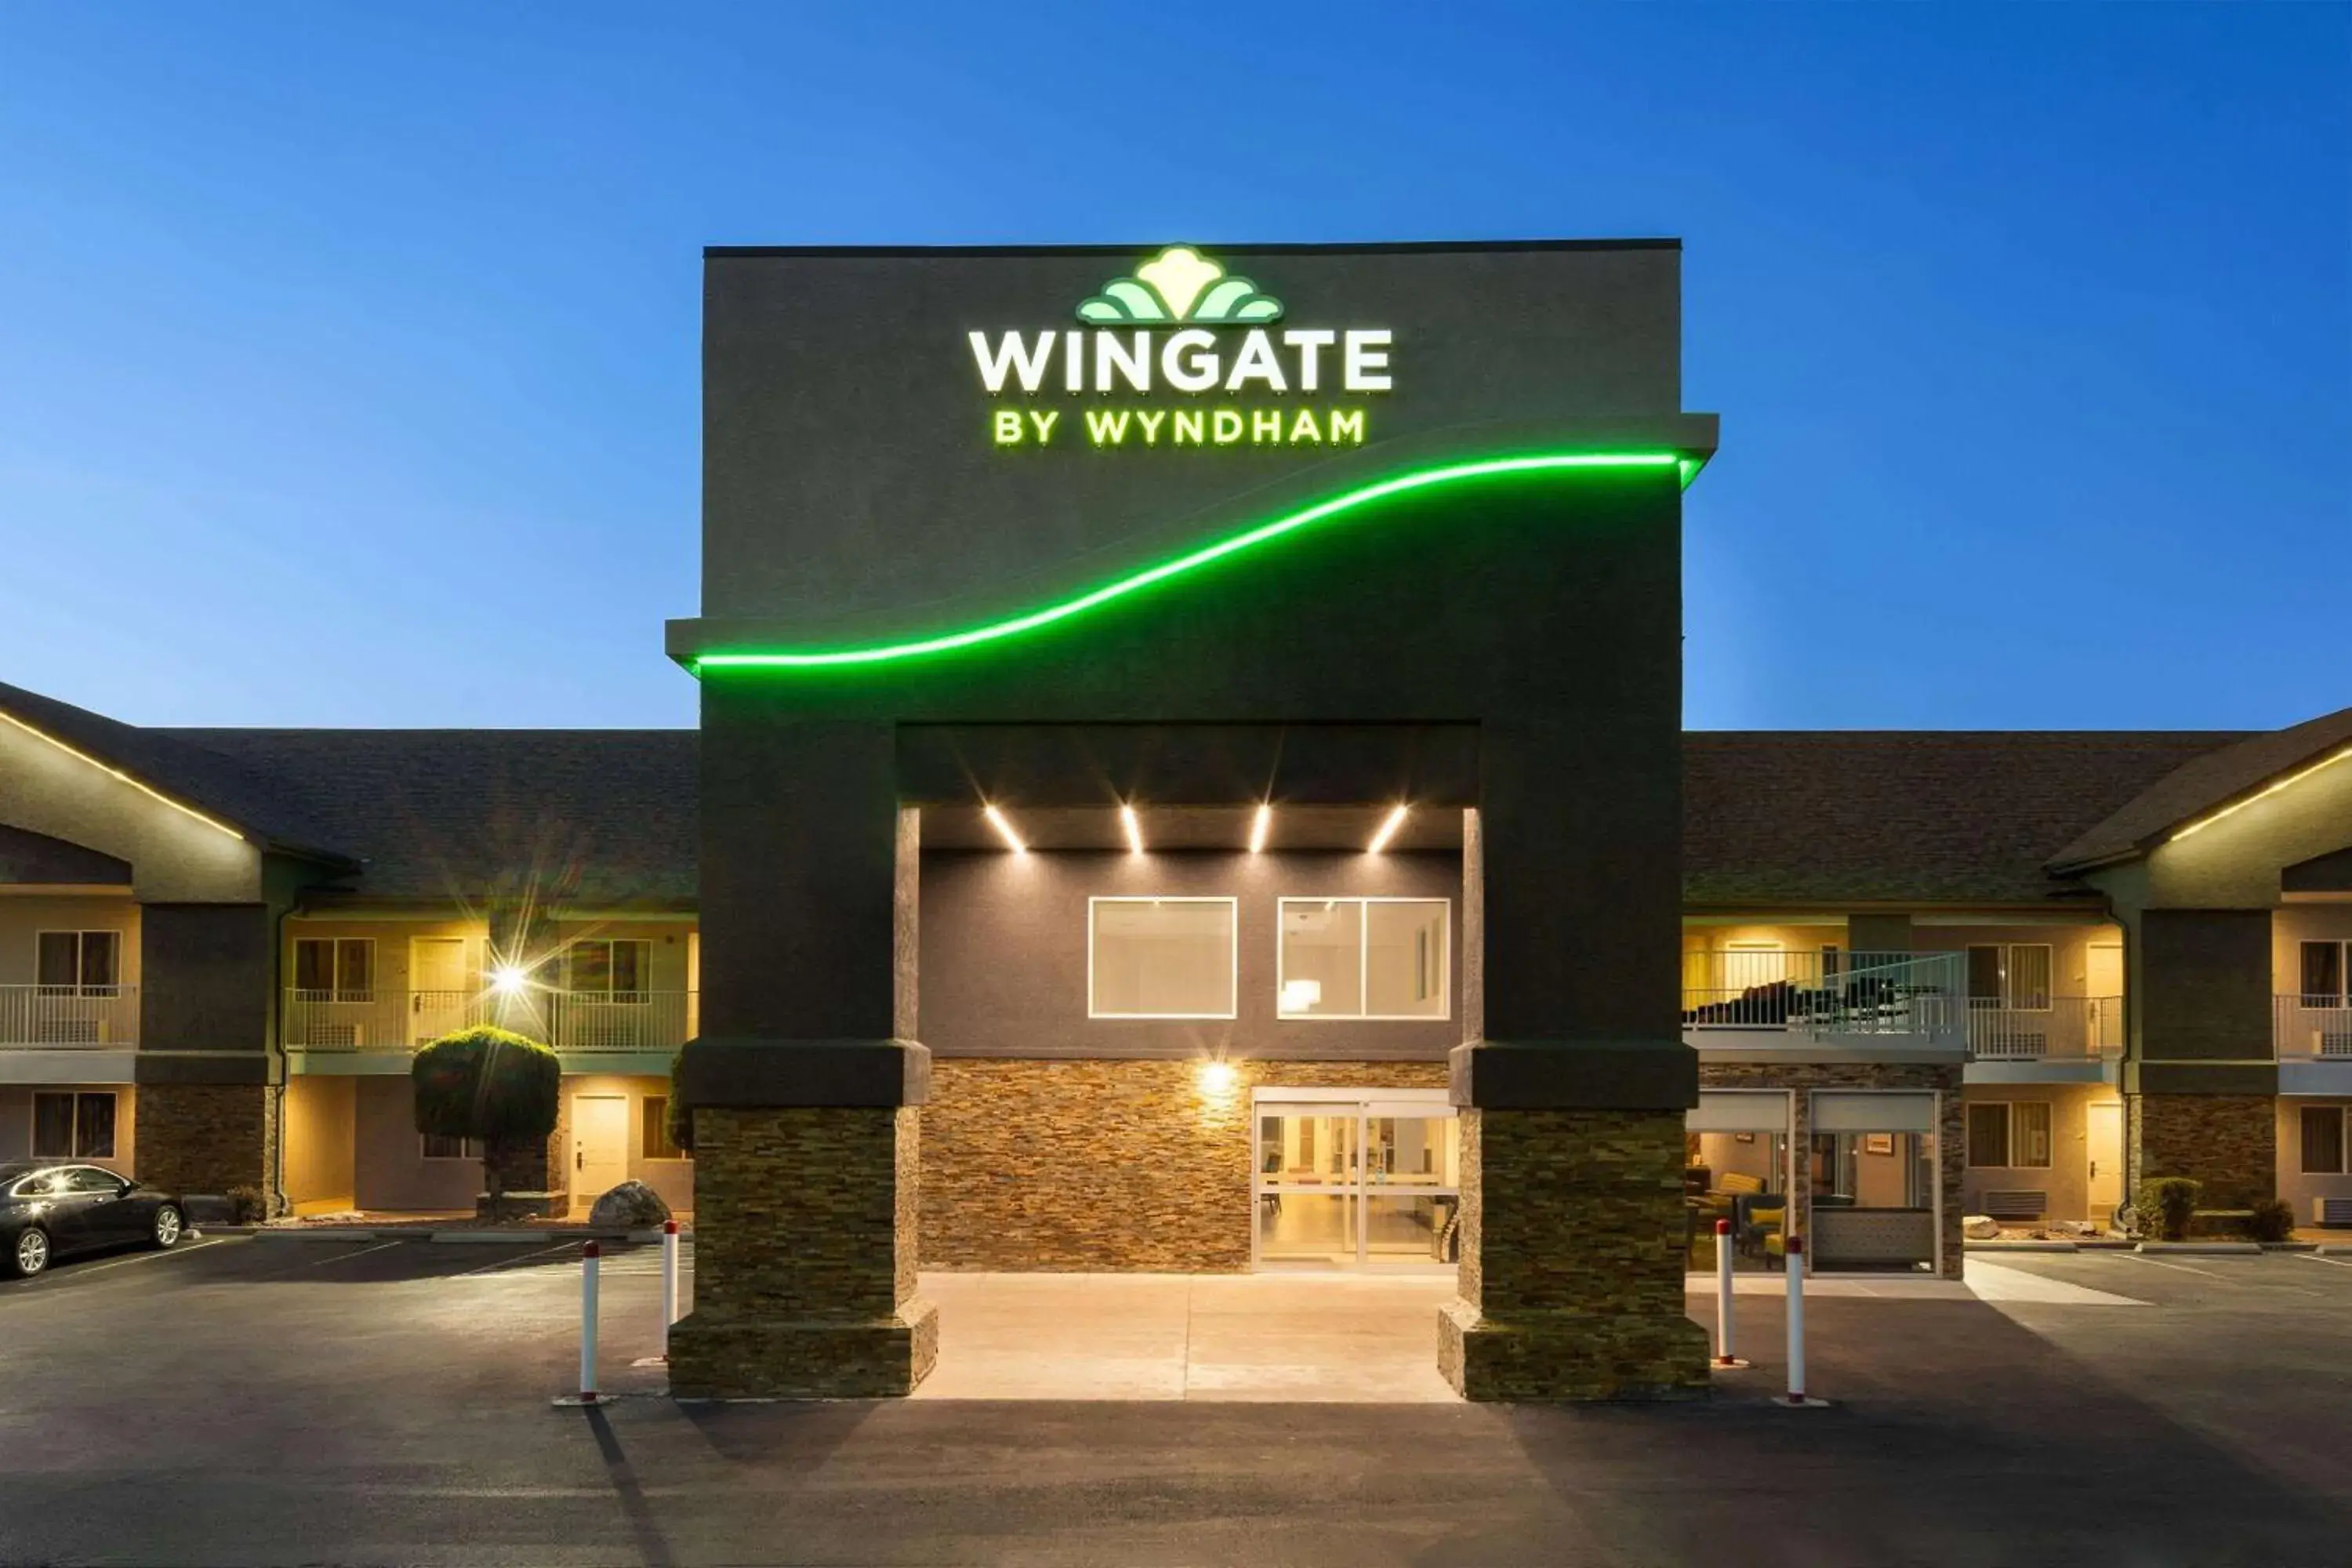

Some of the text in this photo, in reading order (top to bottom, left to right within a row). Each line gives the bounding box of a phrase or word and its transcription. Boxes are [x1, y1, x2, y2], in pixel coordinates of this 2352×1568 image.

[968, 329, 1392, 391] WINGATE
[994, 409, 1365, 444] BY WYNDHAM
